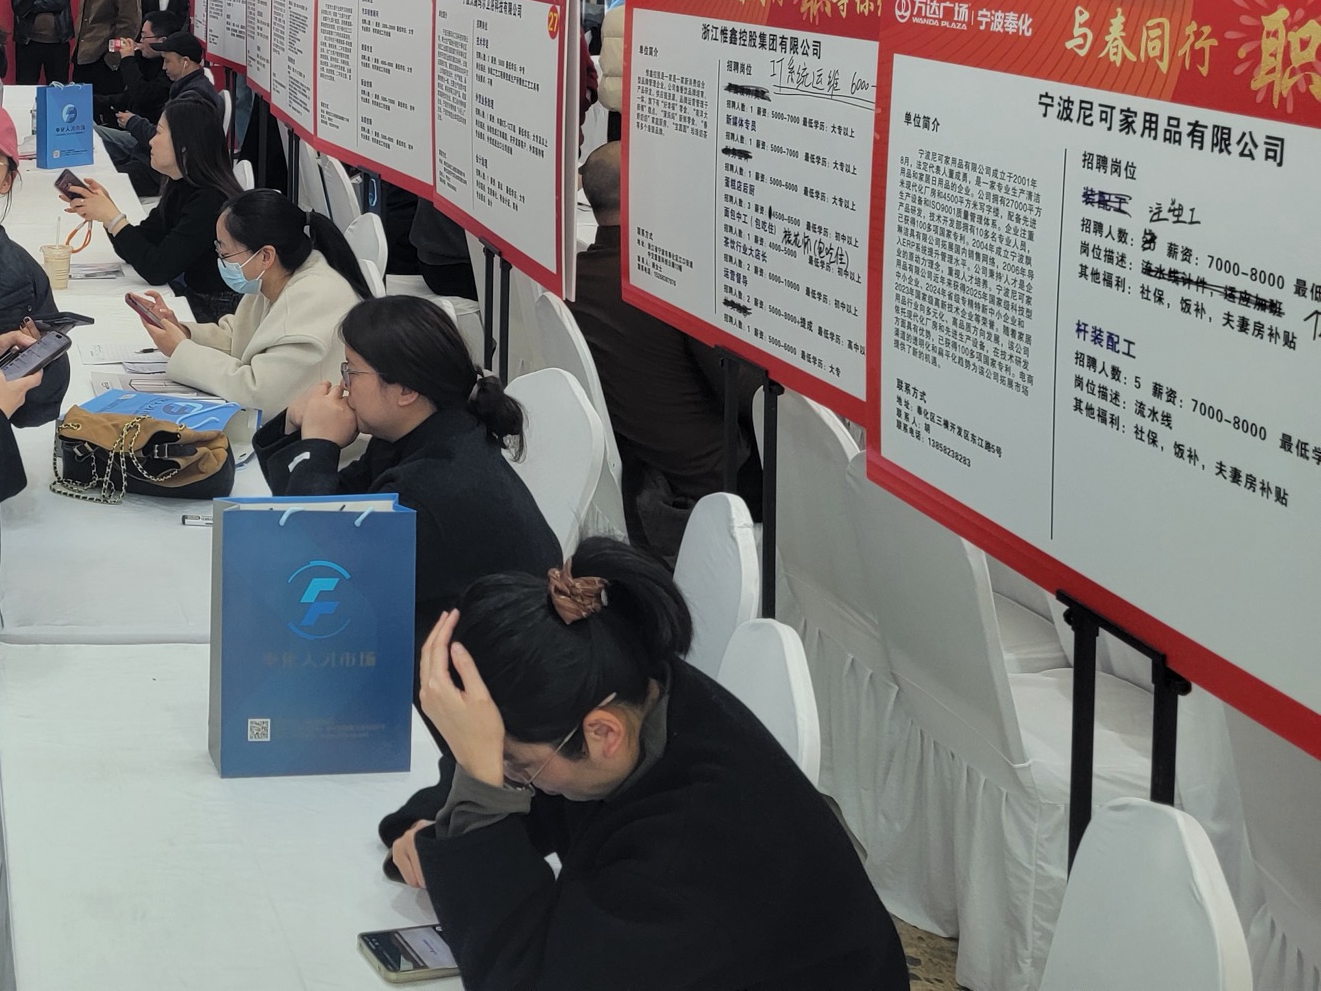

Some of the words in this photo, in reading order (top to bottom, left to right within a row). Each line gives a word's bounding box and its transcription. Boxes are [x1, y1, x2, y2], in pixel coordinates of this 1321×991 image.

[548, 11, 558, 32] 27
[911, 16, 940, 27] WANDA
[941, 20, 968, 30] PLAZA
[977, 9, 1033, 37] 宁波奉化
[638, 45, 659, 57] 单位简介
[726, 60, 752, 76] 招聘岗位
[726, 114, 757, 132] 新媒体专员
[904, 111, 941, 133] 单位简介
[1037, 92, 1287, 167] 宁波尼可家用品有限公司
[918, 148, 1038, 190] 宁波尼可家用品有限公司成立于2001年
[1082, 151, 1137, 180] 招聘岗位
[724, 176, 755, 197] 蛋糕店后厨
[723, 236, 767, 263] 茶饮行业大店长
[723, 268, 748, 287] 运营督导
[1293, 278, 1321, 302] 最低
[1075, 319, 1136, 359] 杆装配工
[896, 378, 927, 404] 联系方式
